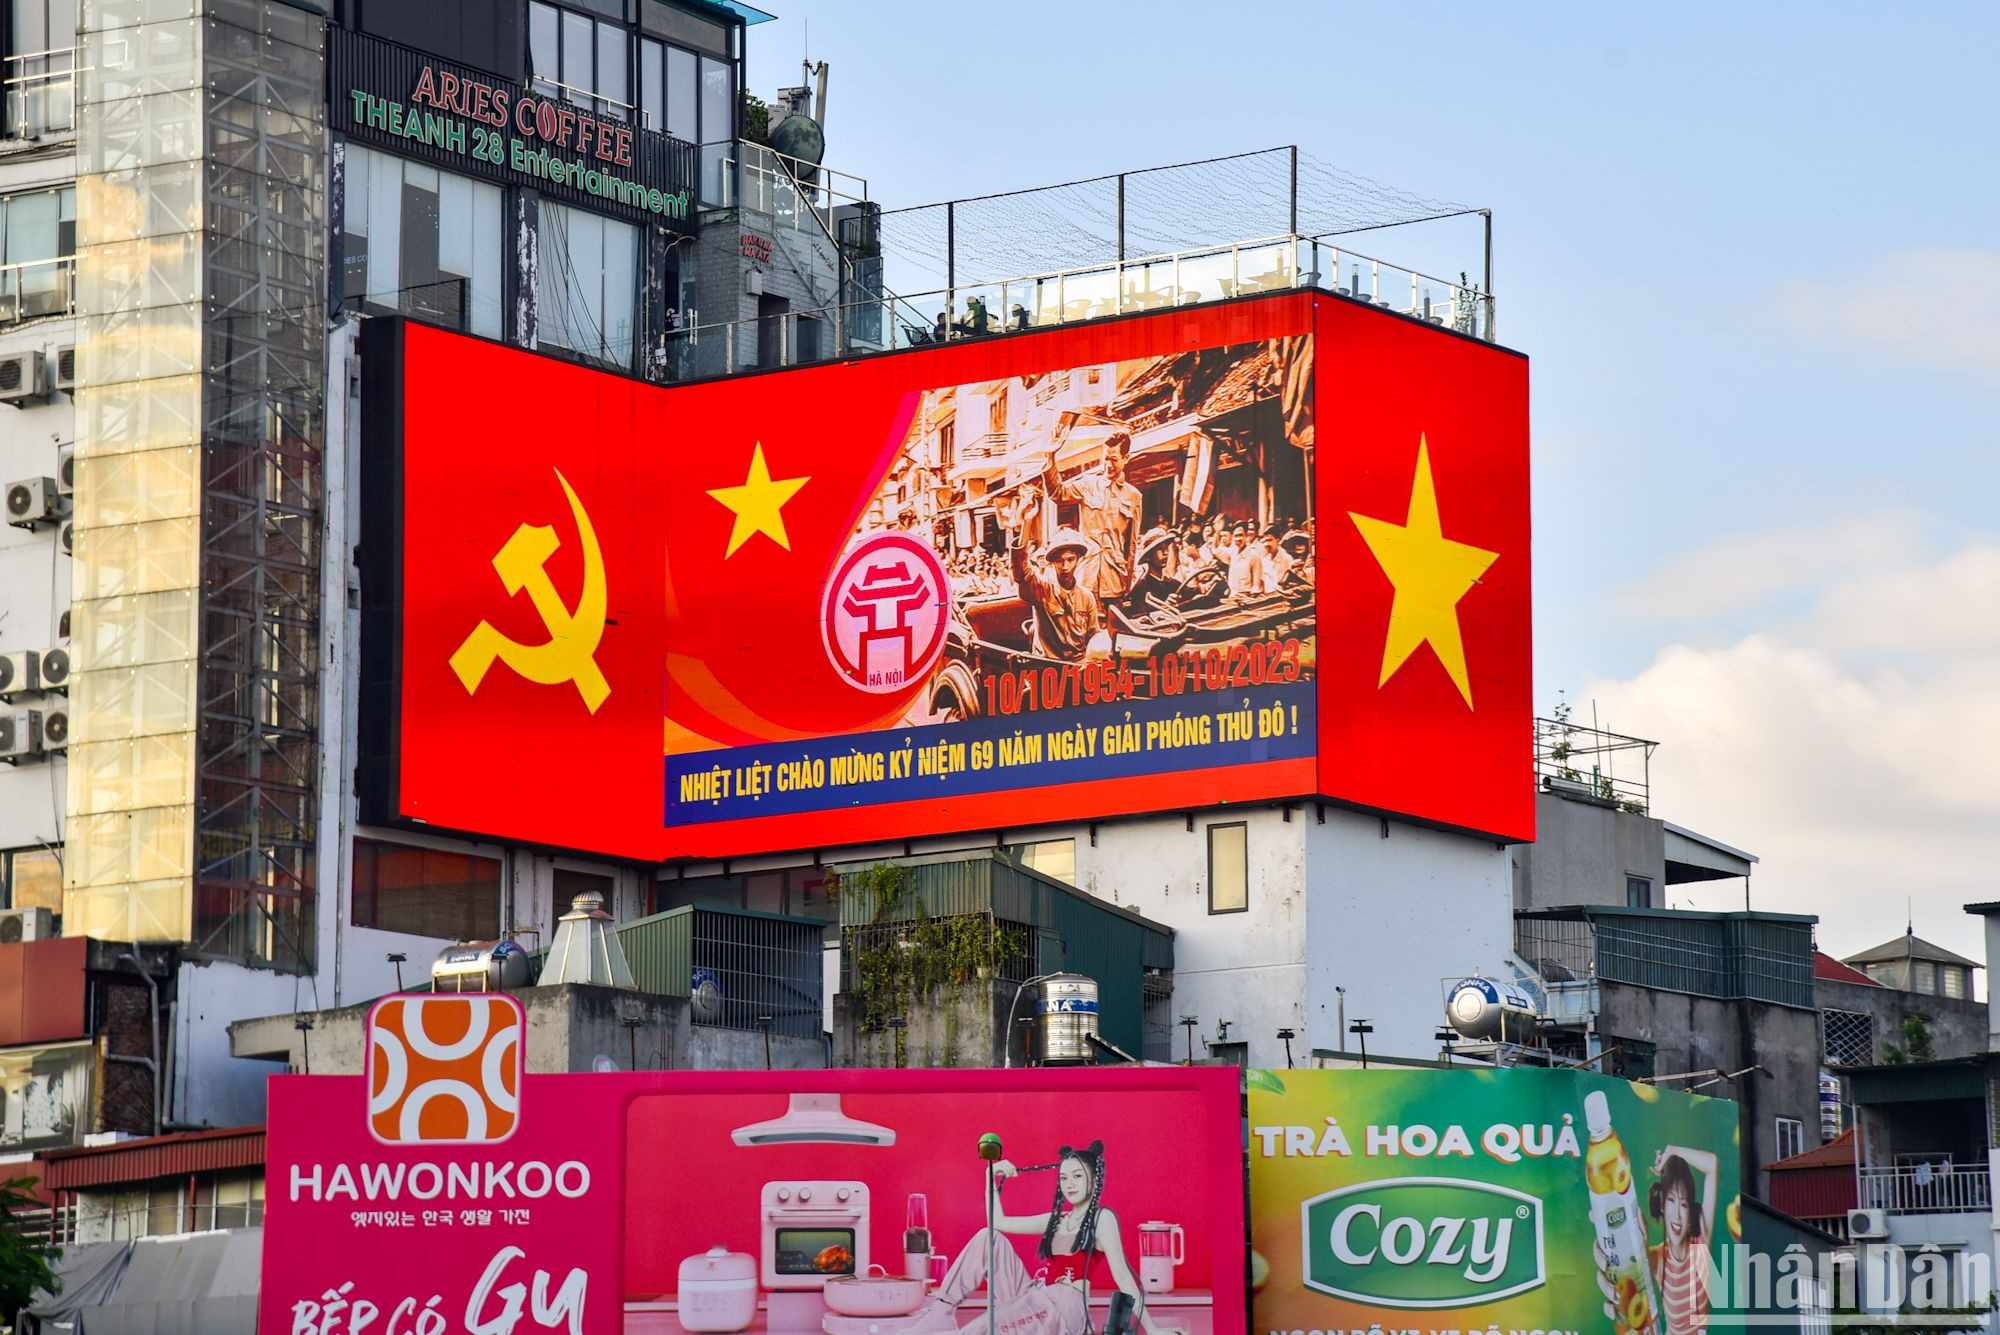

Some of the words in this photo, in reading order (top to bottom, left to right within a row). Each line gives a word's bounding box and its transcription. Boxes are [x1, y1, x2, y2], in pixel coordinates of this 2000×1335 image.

[412, 65, 509, 127] ARIES
[516, 98, 632, 167] COFFEE
[351, 89, 466, 154] THEANH
[472, 128, 505, 165] 28
[511, 139, 688, 221] Entertainment
[869, 670, 882, 686] HÀ
[886, 668, 902, 687] NỘI
[984, 638, 1300, 716] 10/10/1954-10/10/2023
[680, 765, 732, 805] NHIỆT
[736, 760, 772, 800] LIỆT
[777, 754, 823, 792] CHÀO
[830, 748, 884, 785] MỪNG
[890, 737, 912, 779] KỶ
[918, 739, 965, 780] NIỆM
[971, 740, 993, 770] 69
[998, 730, 1042, 767] NĂM
[1048, 723, 1098, 762] NGÀY
[1103, 711, 1141, 756] GIẢI
[1147, 712, 1211, 750] PHÓNG
[1217, 697, 1253, 740] THỦ
[1258, 700, 1285, 738] ĐÔ
[1291, 704, 1298, 735] !
[1253, 1116, 1352, 1157] TRÀ
[1366, 1124, 1474, 1157] HOA
[1482, 1113, 1581, 1163] QUẢ
[290, 1160, 590, 1201] HAWONKOO
[422, 1209, 453, 1227] 한국
[460, 1209, 492, 1226] 생활
[498, 1209, 530, 1226] 가전
[1330, 1203, 1514, 1283] Cozy
[291, 1281, 379, 1335] BẾP
